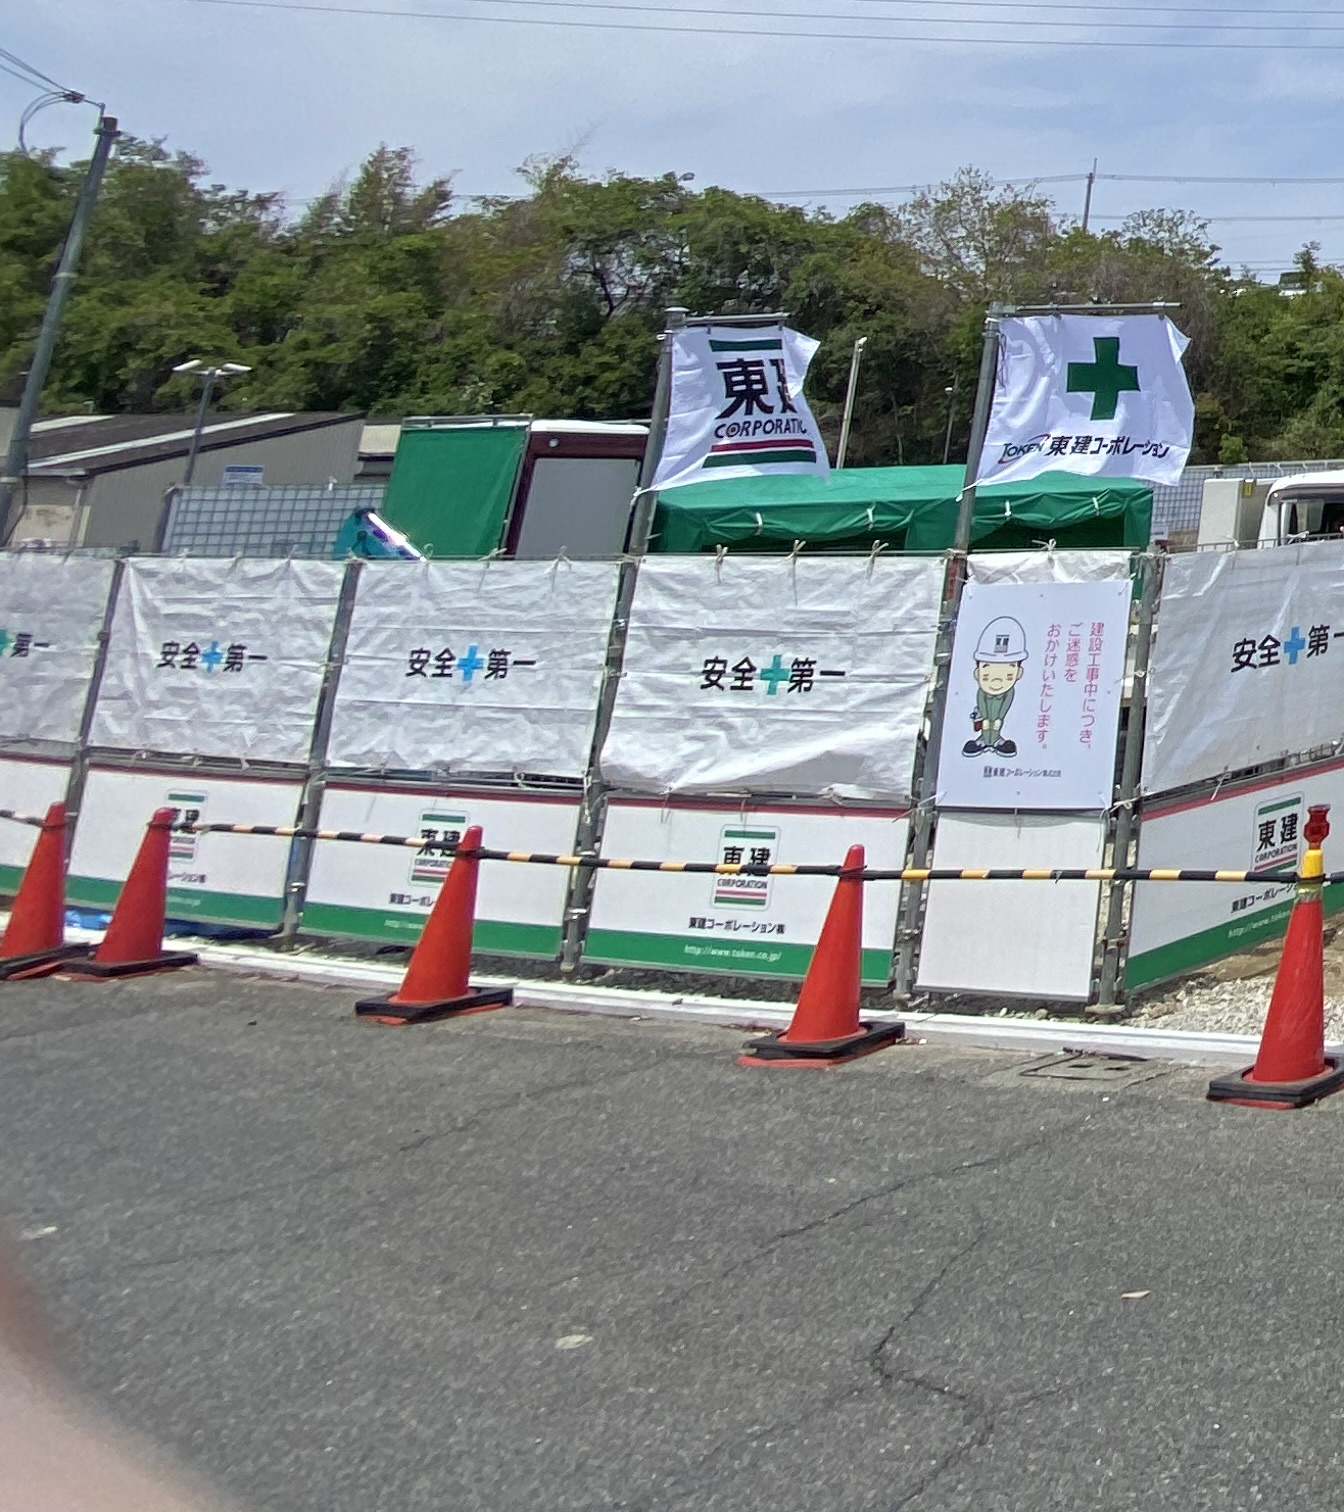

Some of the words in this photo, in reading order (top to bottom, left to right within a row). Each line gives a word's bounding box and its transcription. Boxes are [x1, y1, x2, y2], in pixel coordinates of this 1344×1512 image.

[1045, 435, 1170, 459] 東建コーポレーション
[1063, 621, 1085, 683] ご迷惑を
[1256, 813, 1299, 852] 東建
[1254, 843, 1298, 864] CORPORATION
[717, 878, 768, 889] CORPORATION
